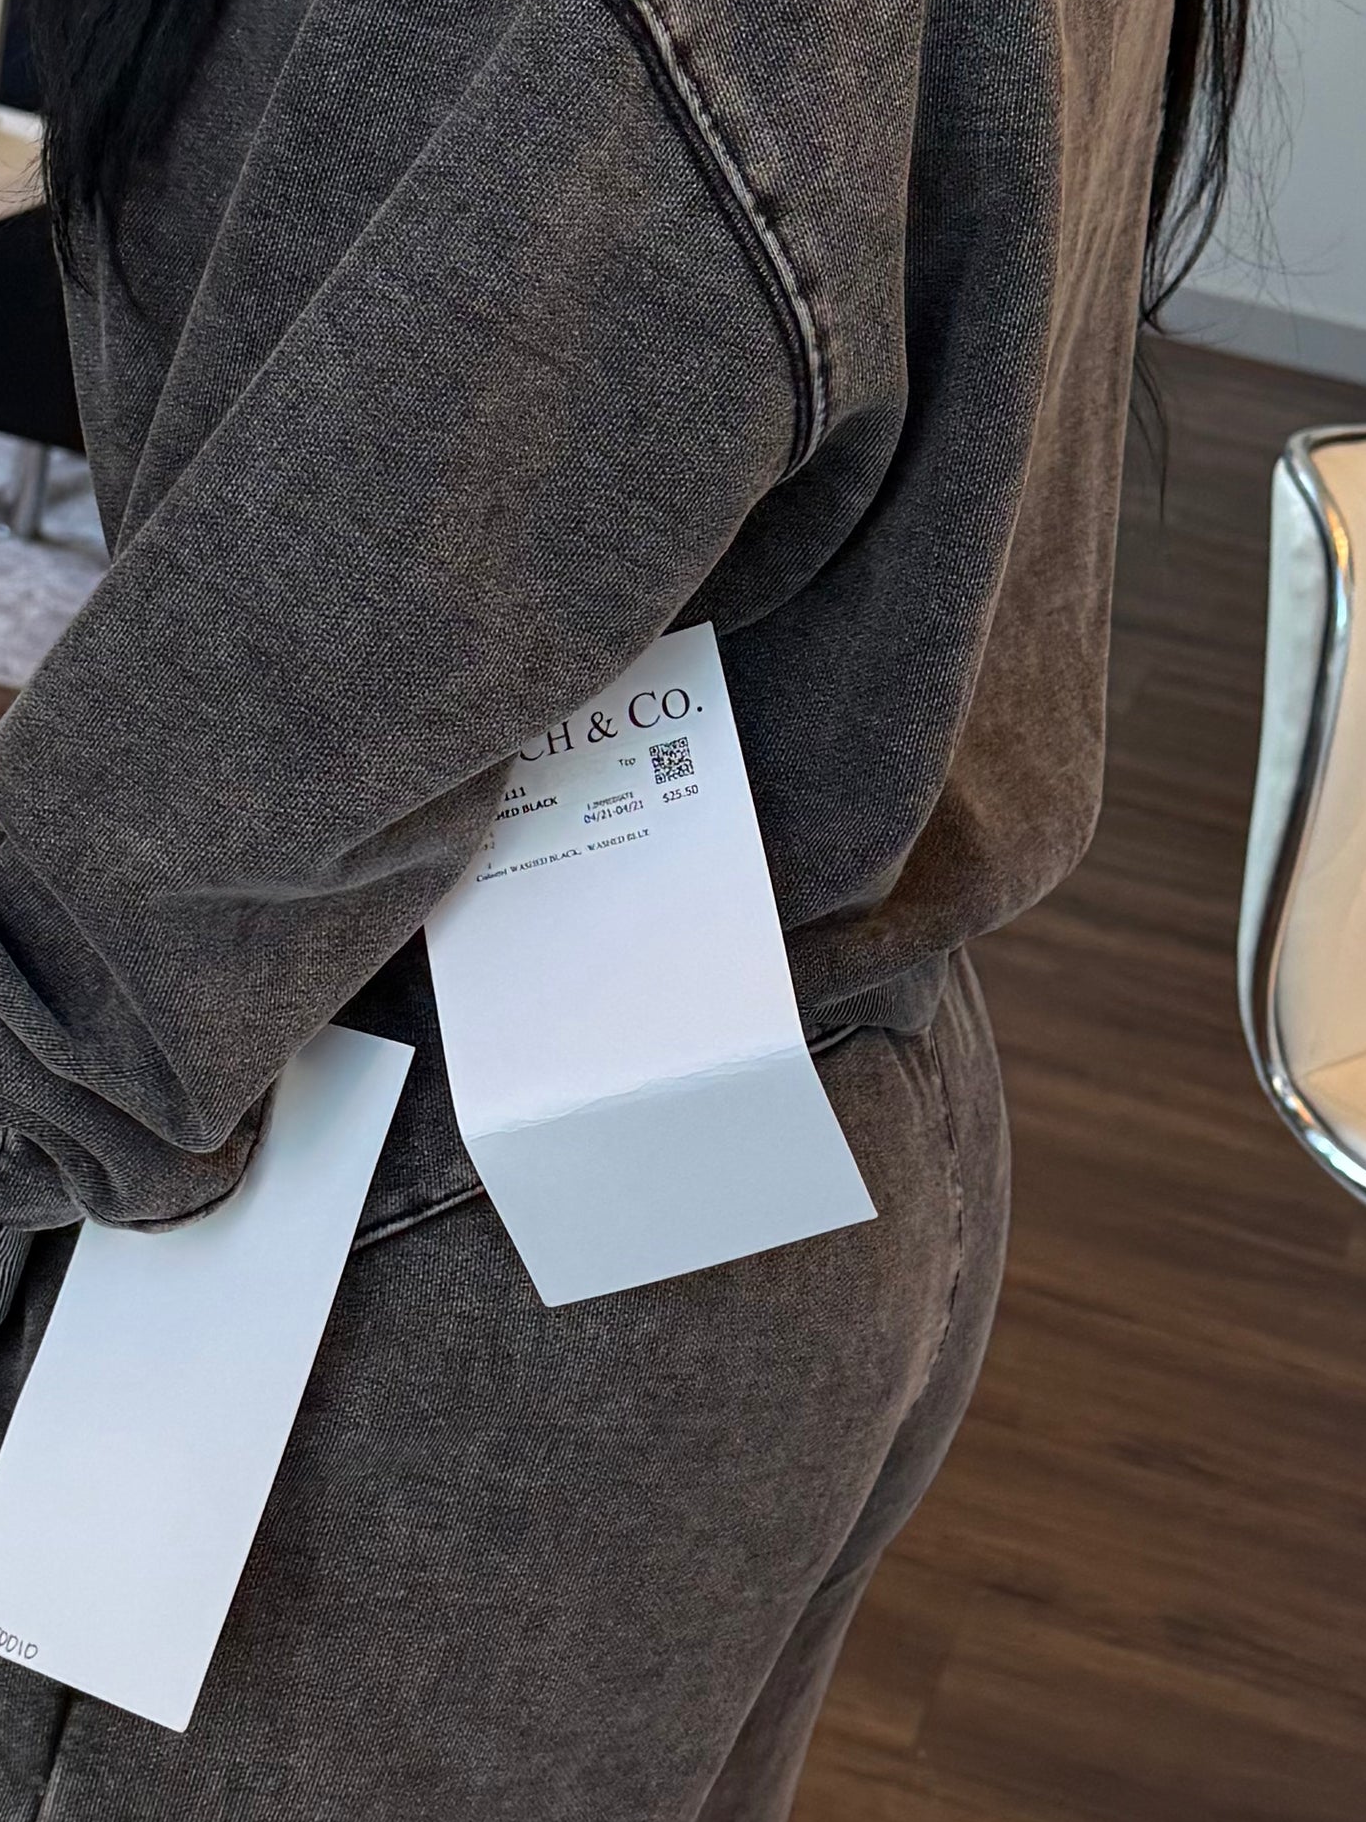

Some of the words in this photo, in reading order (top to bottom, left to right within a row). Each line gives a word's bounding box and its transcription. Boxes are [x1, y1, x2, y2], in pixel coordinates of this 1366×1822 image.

[587, 711, 619, 744] &
[628, 688, 703, 729] CO.
[662, 784, 700, 804] $25.50
[494, 806, 520, 821] HED
[522, 796, 558, 814] BLACK
